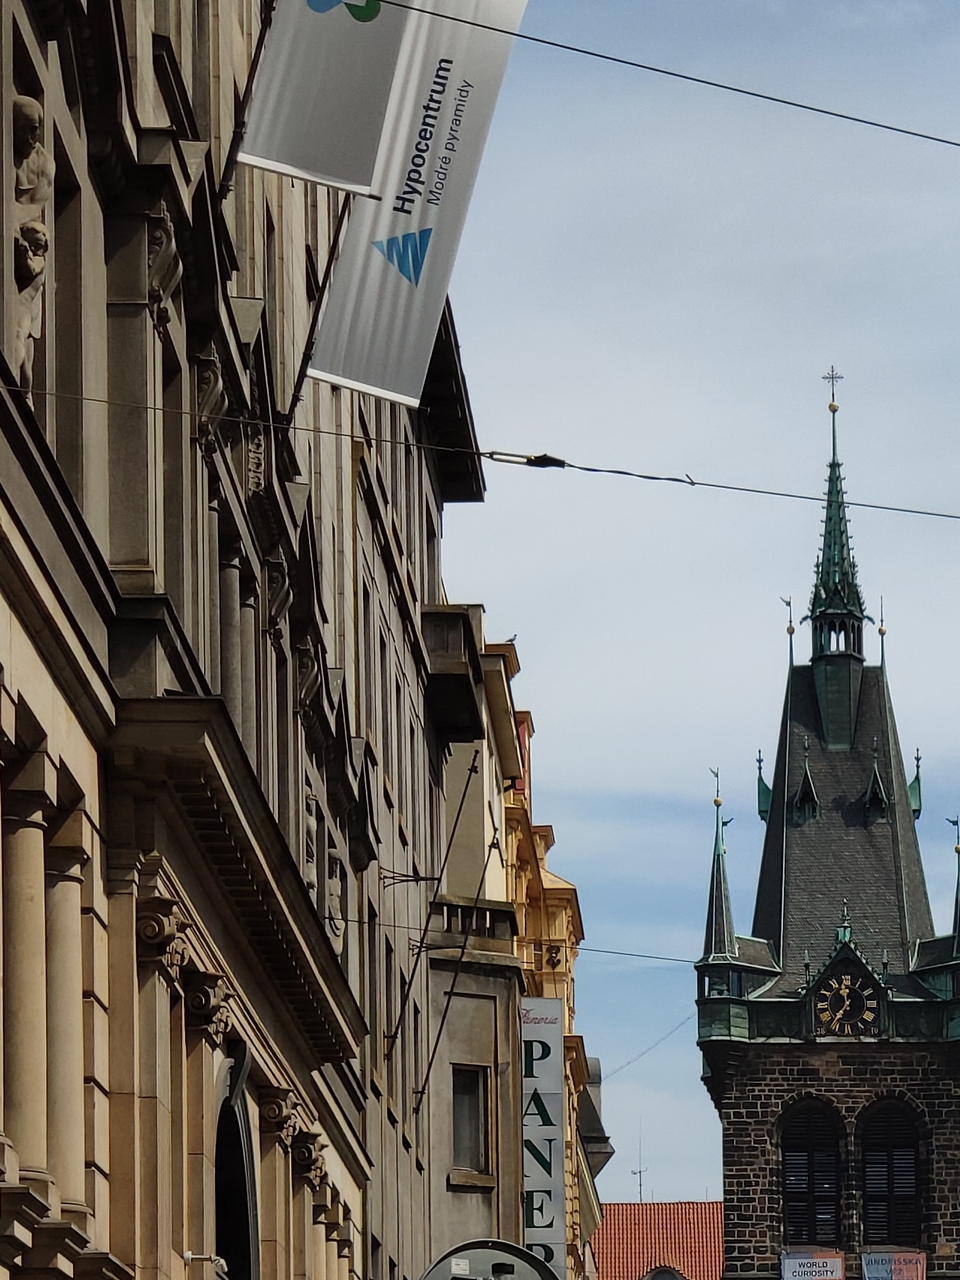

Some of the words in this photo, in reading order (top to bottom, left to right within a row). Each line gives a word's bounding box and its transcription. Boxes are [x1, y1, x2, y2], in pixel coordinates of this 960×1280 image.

[392, 58, 454, 216] Hypocentrum
[426, 156, 452, 206] Modré
[444, 79, 475, 153] pyramidy
[791, 1270, 835, 1278] CURIOSITY
